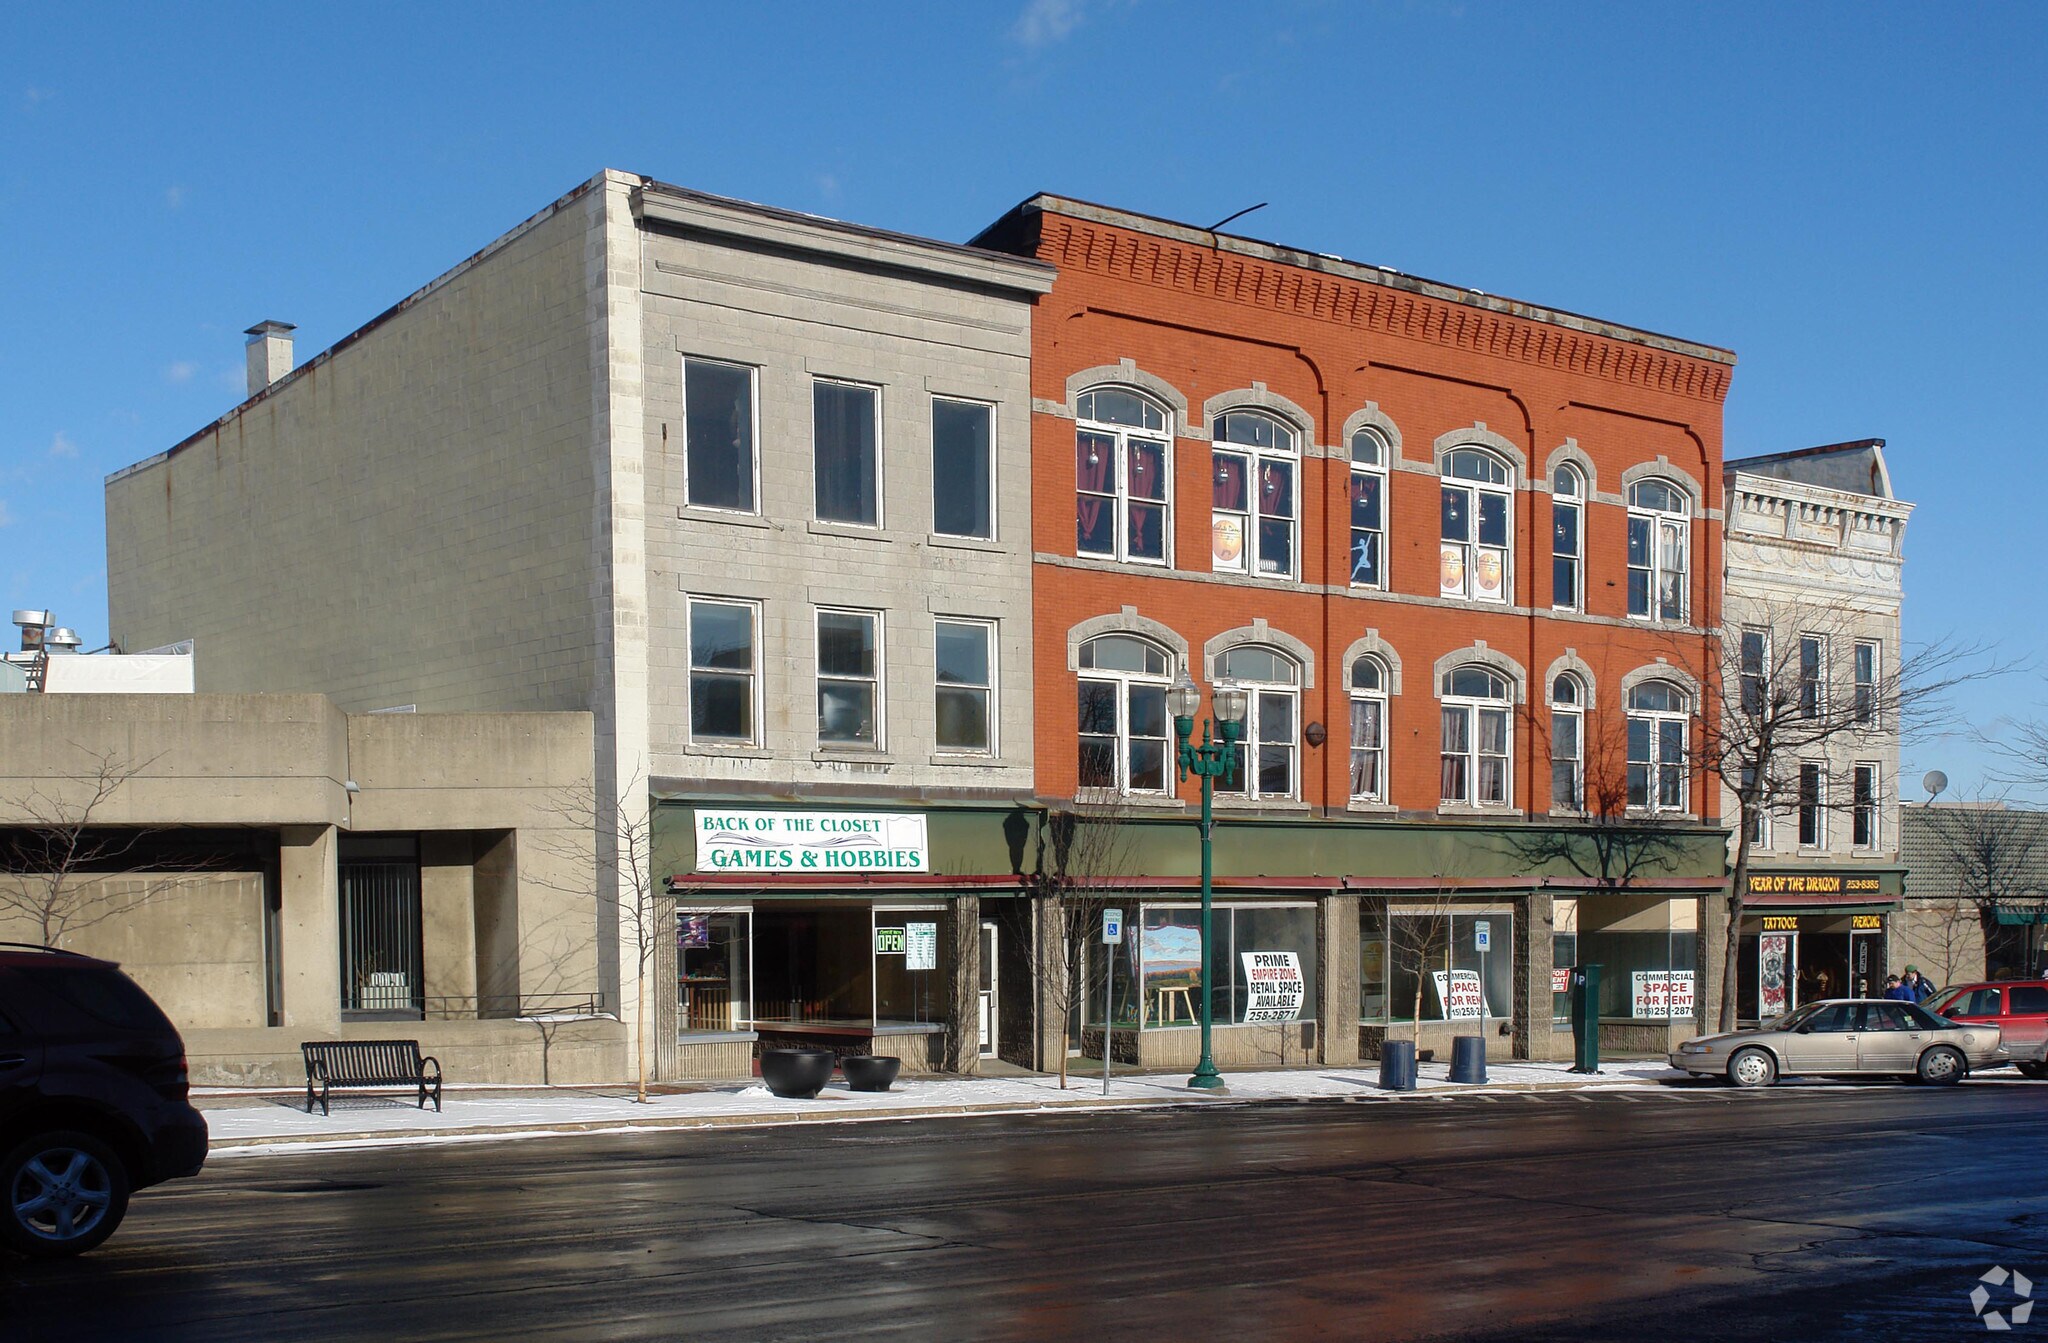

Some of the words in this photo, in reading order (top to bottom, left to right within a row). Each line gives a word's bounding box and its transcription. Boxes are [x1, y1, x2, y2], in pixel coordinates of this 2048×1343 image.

[703, 817, 749, 831] BACK
[755, 818, 776, 831] OF
[783, 818, 815, 831] THE
[820, 819, 881, 832] CLOSET
[711, 849, 793, 867] GAMES
[800, 850, 818, 867] &
[825, 850, 920, 867] HOBBIES
[1749, 876, 1772, 892] YEAR
[1774, 876, 1786, 892] OF
[1787, 876, 1805, 892] THE
[1806, 876, 1840, 892] DRAGON
[1763, 916, 1798, 930] TATTOOZ
[878, 935, 904, 951] OPEN
[1254, 954, 1290, 967] PRIME
[1251, 968, 1278, 981] EMPIRE
[1279, 968, 1298, 980] ZONE
[1635, 973, 1694, 981] COMMERCIAL
[1250, 982, 1277, 994] RETAIL
[1278, 981, 1302, 994] SPACE
[1643, 982, 1687, 993] SPACE
[1255, 995, 1296, 1007] AVAILABLE
[1465, 995, 1482, 1006] REN
[1636, 995, 1660, 1005] FOR
[1663, 995, 1693, 1005] RENT
[1248, 1010, 1296, 1021] 258-2871
